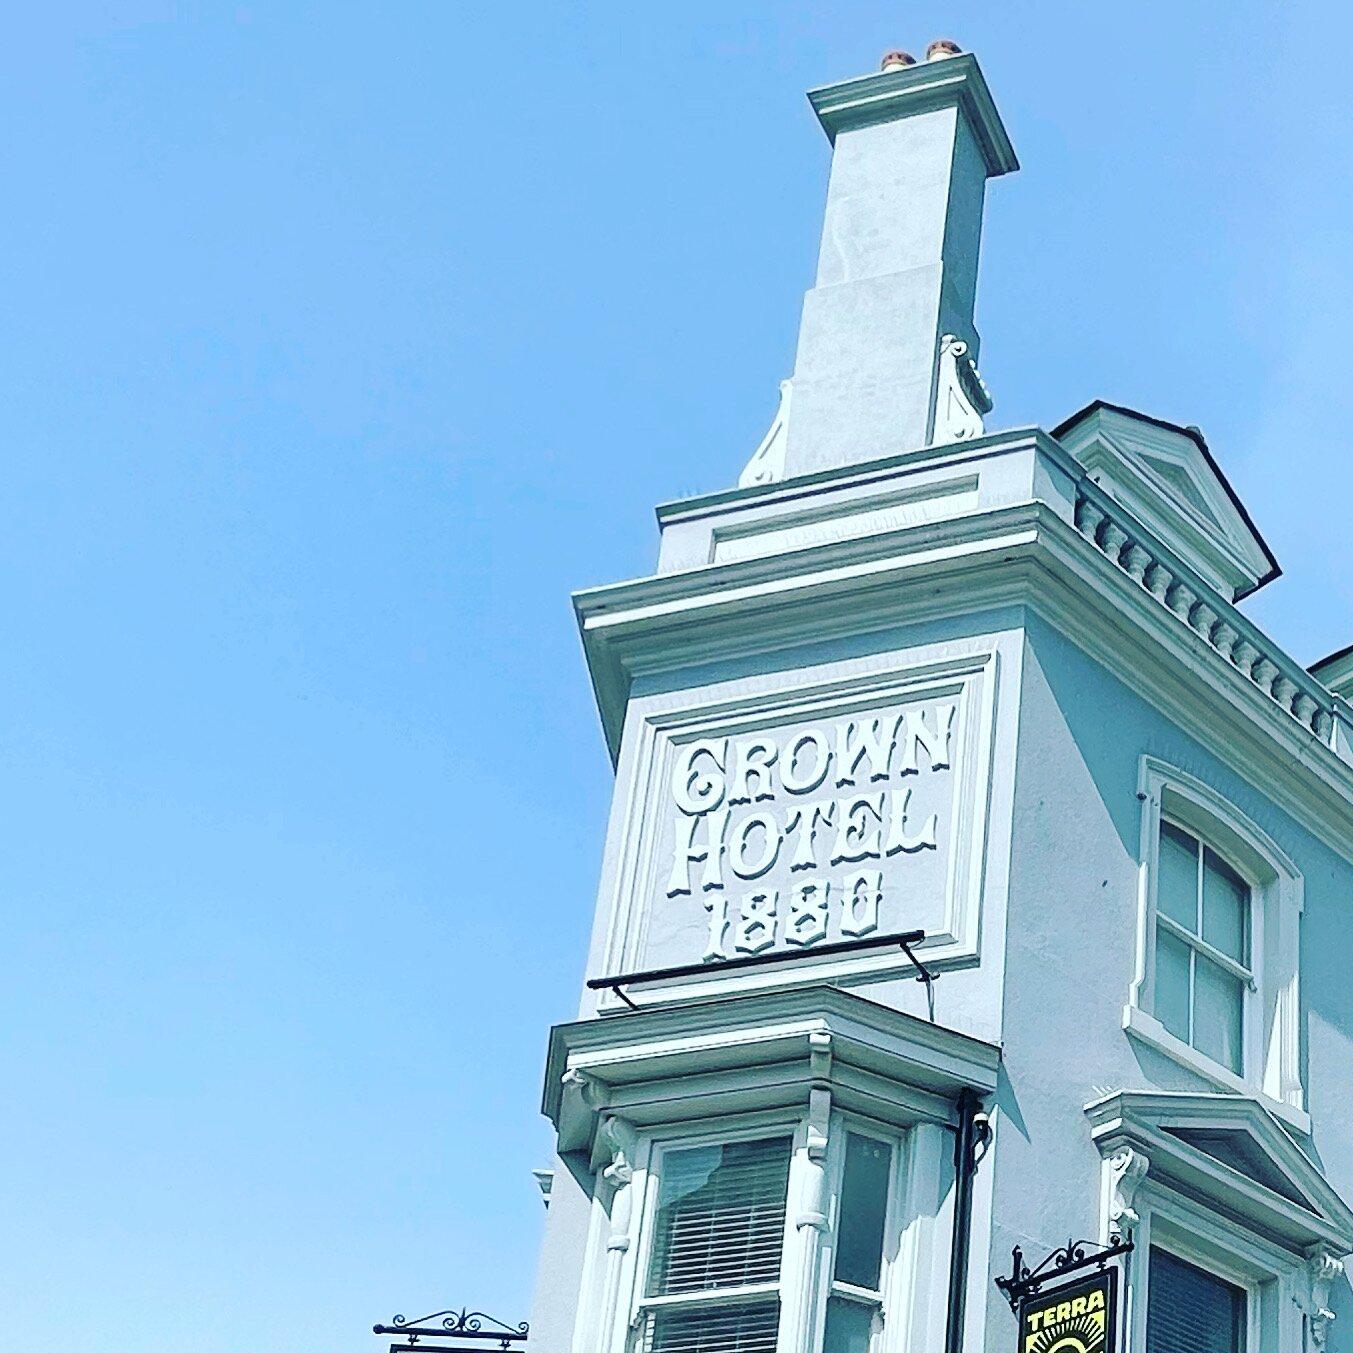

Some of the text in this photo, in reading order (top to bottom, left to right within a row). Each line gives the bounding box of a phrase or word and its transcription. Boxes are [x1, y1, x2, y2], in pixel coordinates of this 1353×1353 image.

[671, 704, 956, 816] CROWN
[667, 788, 937, 898] HOTEL
[702, 870, 883, 962] 1880
[1027, 1289, 1105, 1332] TERRA
